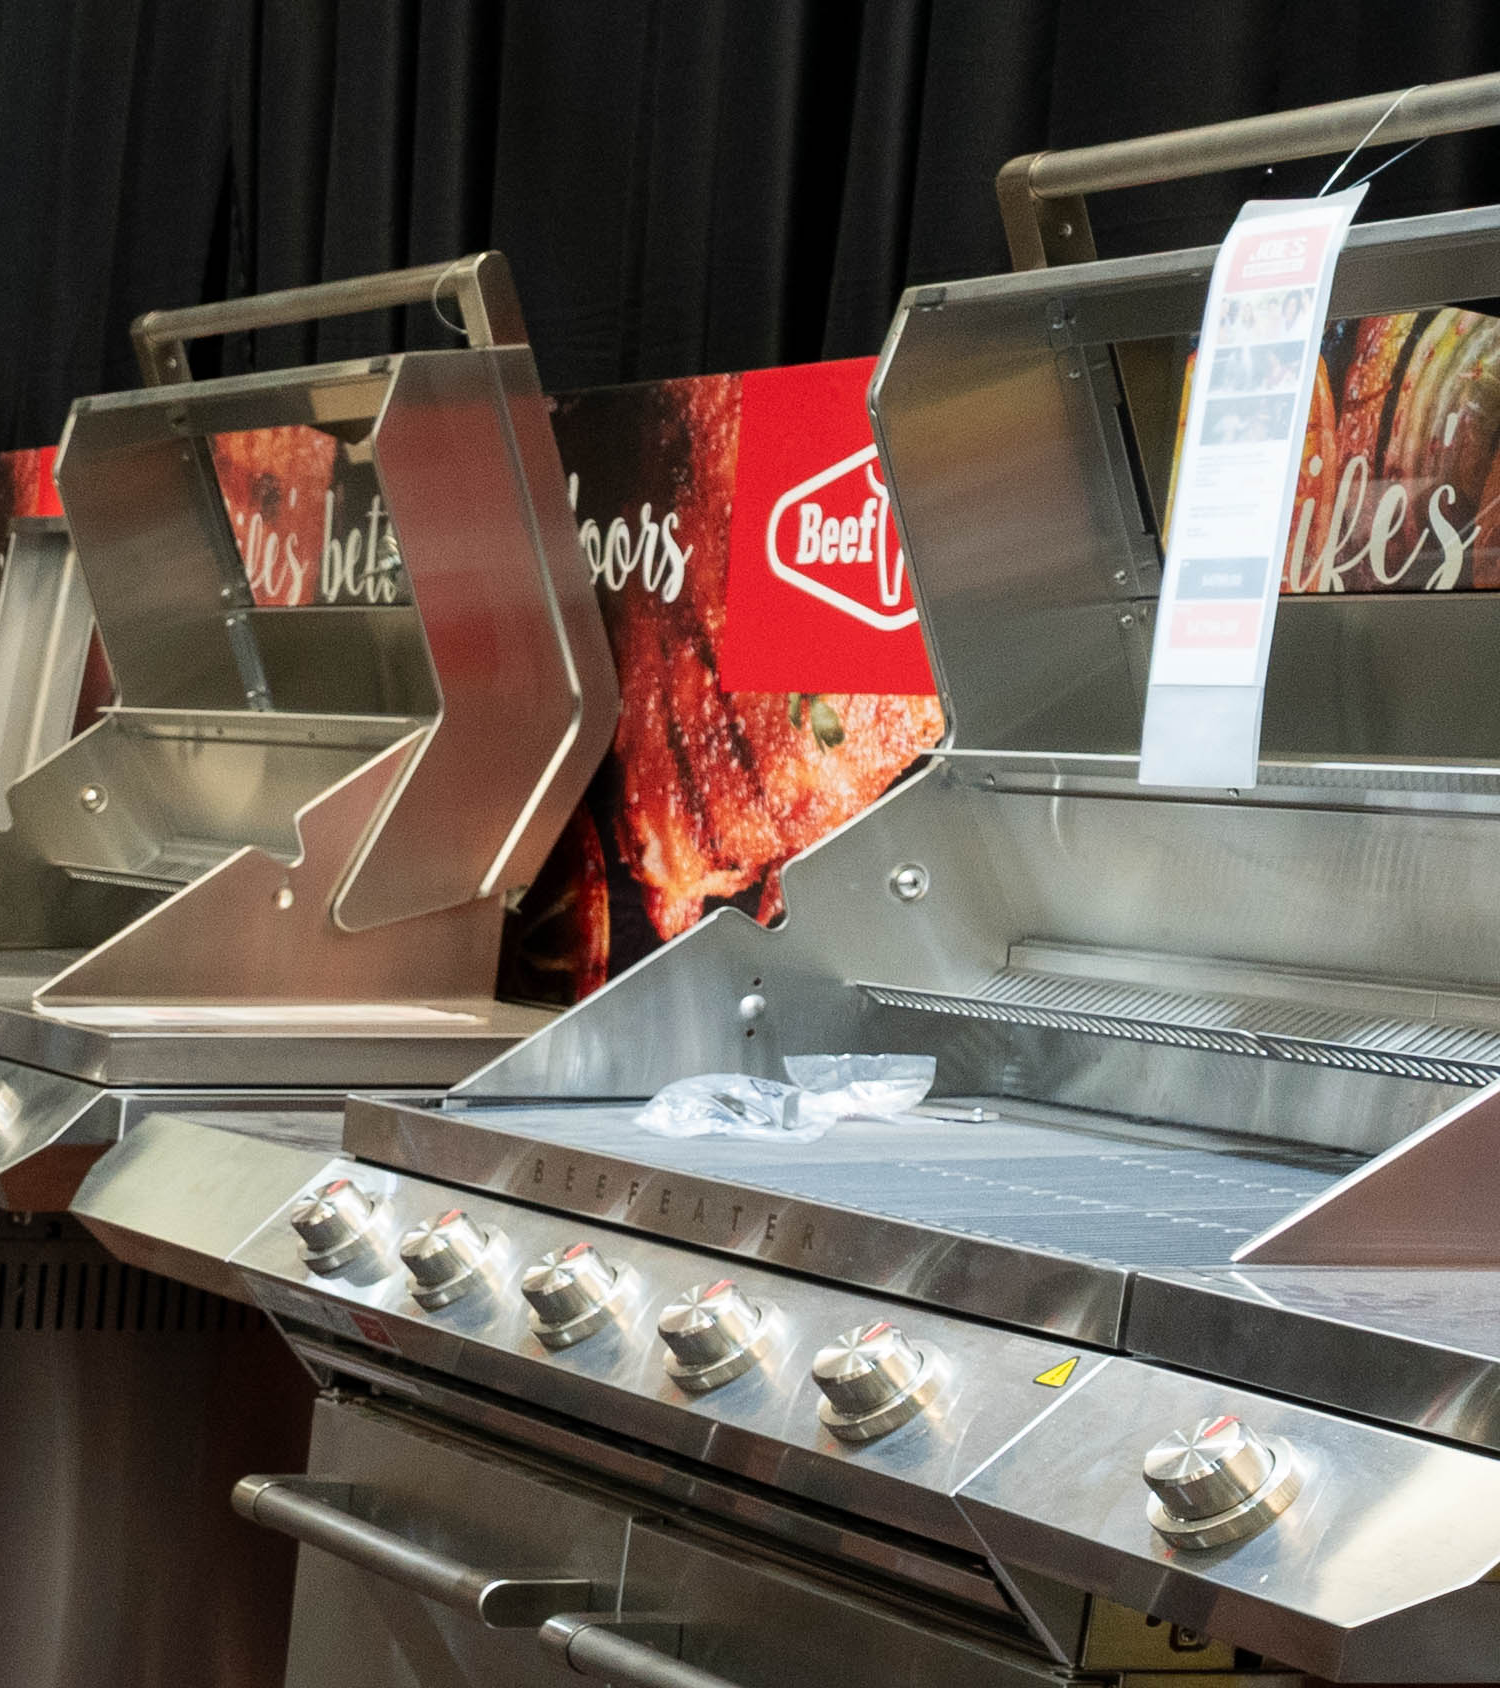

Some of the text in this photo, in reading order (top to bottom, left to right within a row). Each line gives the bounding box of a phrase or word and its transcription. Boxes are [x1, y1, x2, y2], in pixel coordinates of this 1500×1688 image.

[795, 497, 879, 565] Beef
[1280, 411, 1482, 592] ife's
[532, 1158, 815, 1250] BEEFEATER
